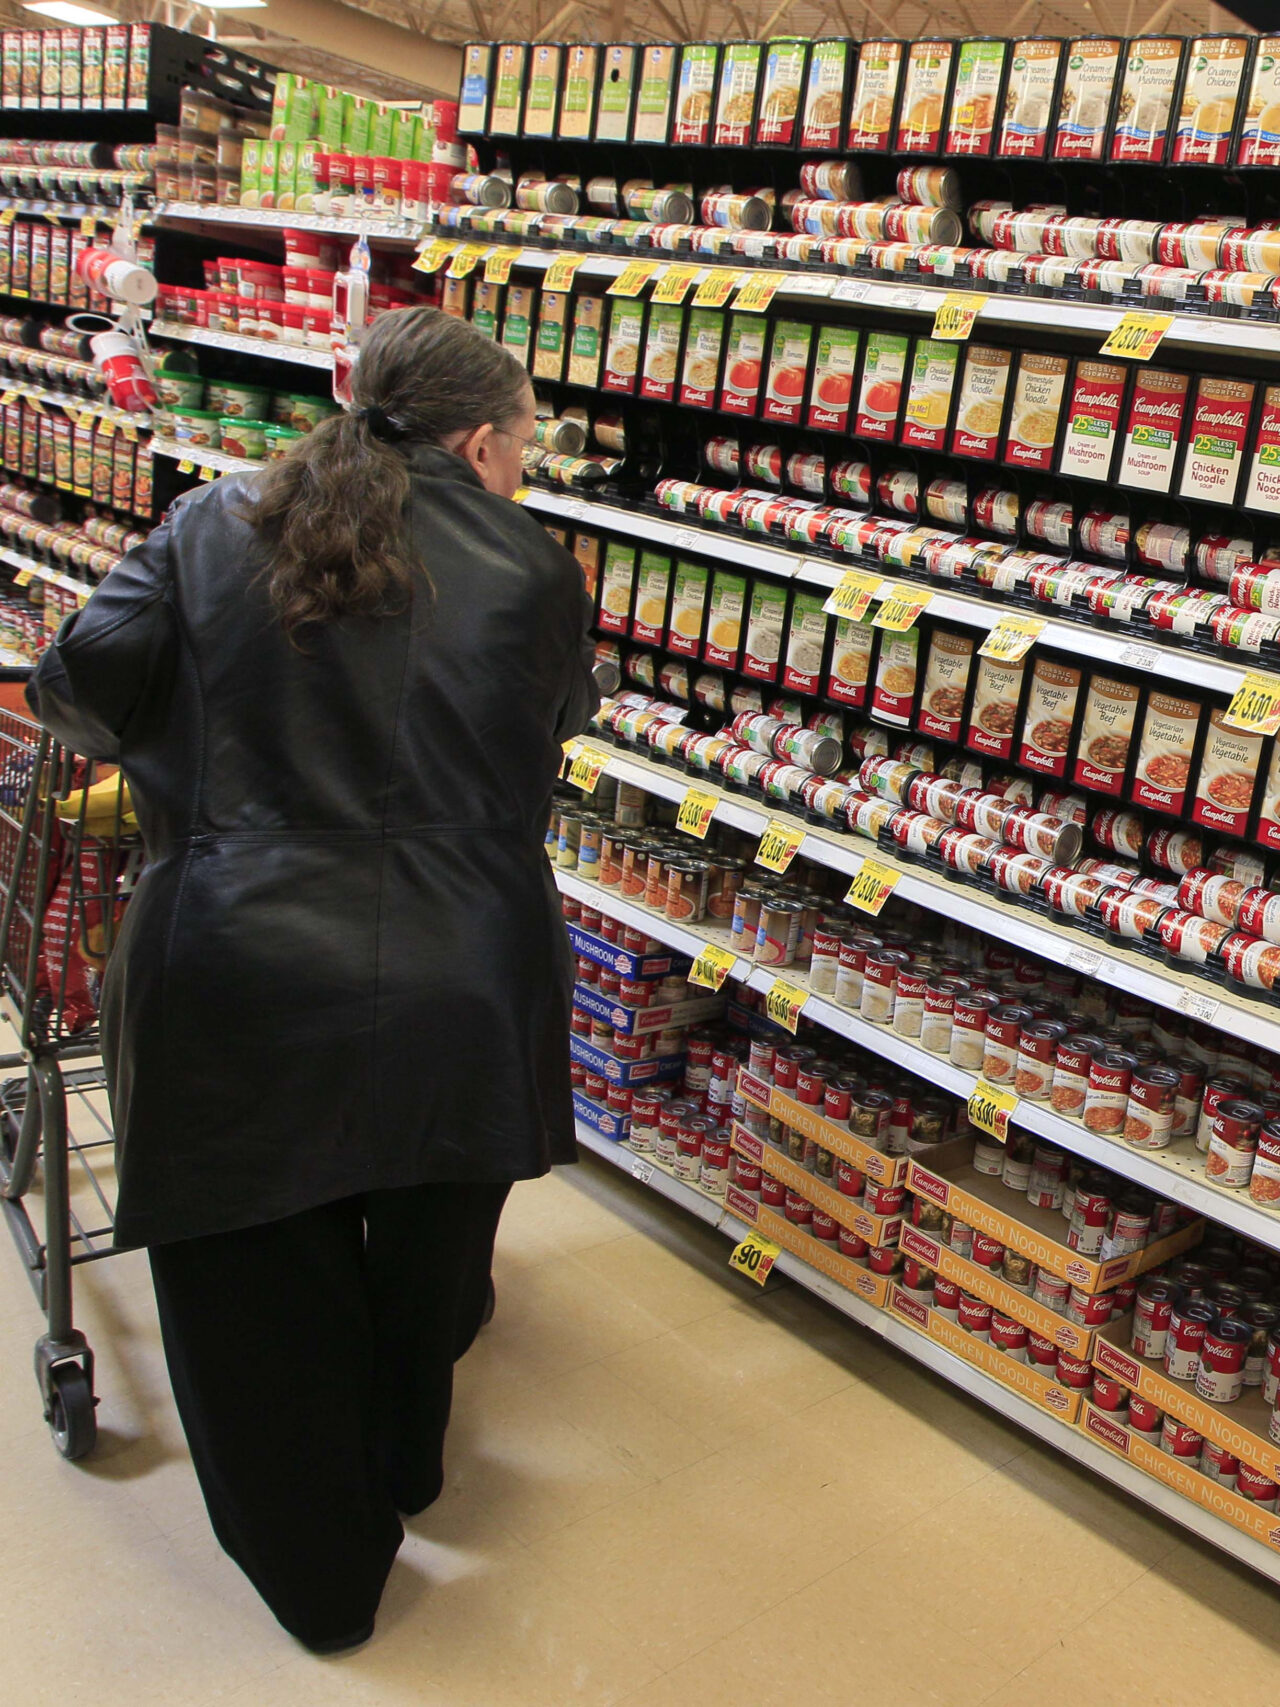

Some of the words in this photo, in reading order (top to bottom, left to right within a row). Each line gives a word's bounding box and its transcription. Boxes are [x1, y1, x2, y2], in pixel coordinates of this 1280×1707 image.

[1127, 458, 1167, 473] Mushroom
[1092, 698, 1128, 717] Vegetable
[1230, 688, 1272, 723] 2/3.00
[1099, 711, 1117, 726] Beef
[1211, 746, 1249, 764] Vegetable
[1215, 736, 1249, 752] Vegetarian
[574, 935, 615, 964] MUSHROOM
[773, 1099, 817, 1136] CHICKEN
[819, 1127, 862, 1162] NOODLE
[951, 1196, 1004, 1238] CHICKEN
[1009, 1229, 1061, 1270] NOODLE
[1144, 1378, 1203, 1424] CHICKEN
[1209, 1421, 1270, 1469] NOODLE
